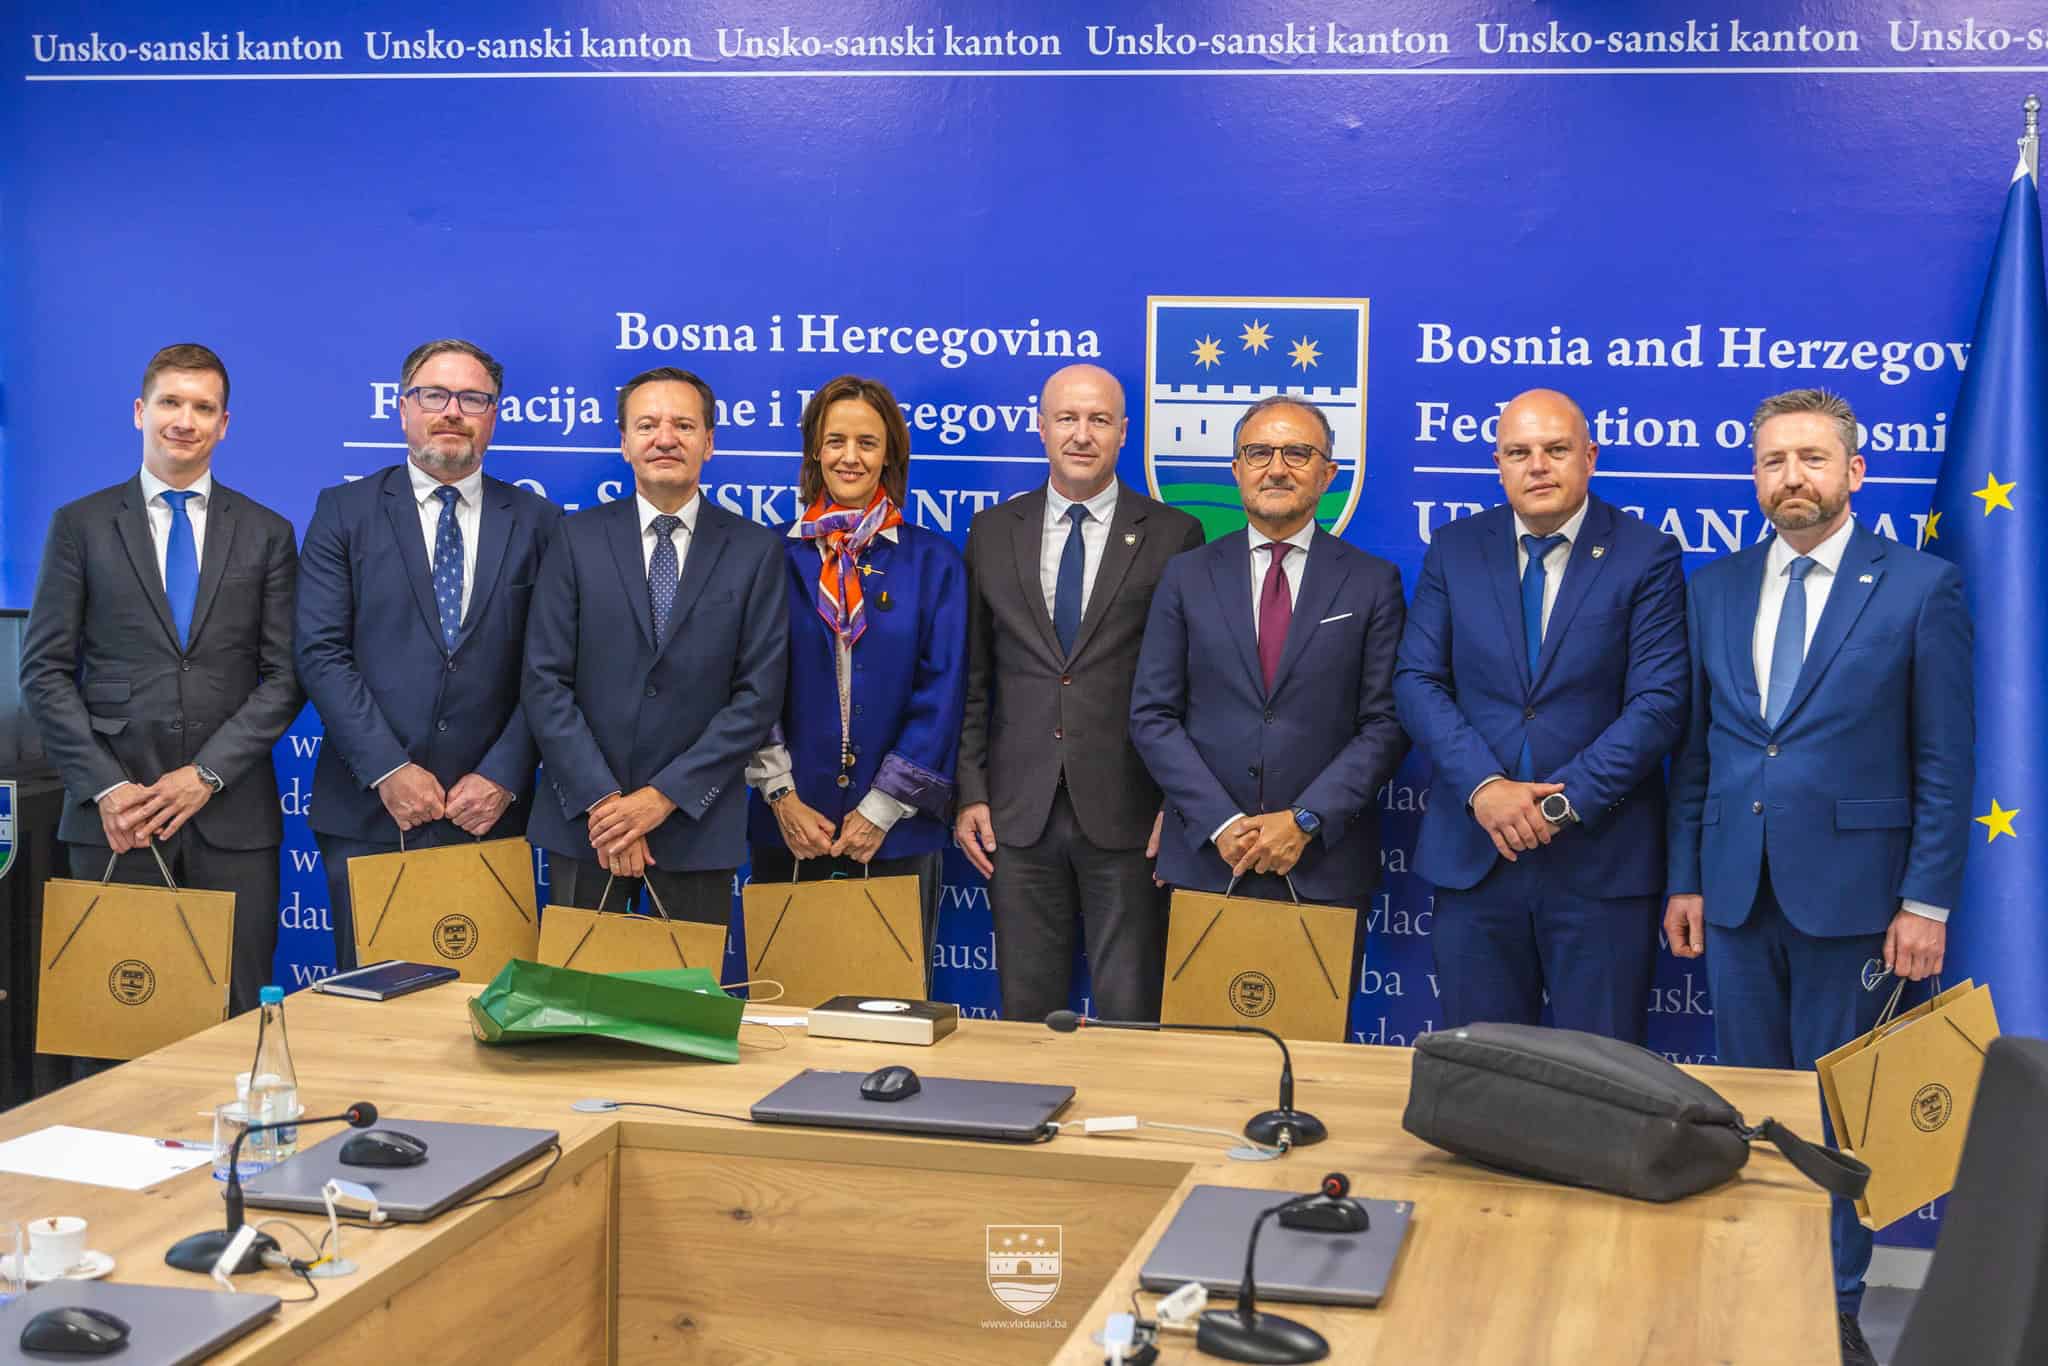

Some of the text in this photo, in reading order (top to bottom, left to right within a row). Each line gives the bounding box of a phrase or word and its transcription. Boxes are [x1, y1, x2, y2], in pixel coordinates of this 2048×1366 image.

[32, 16, 2048, 62] Unsko-sanski kanton Unsko-sanski kanton Unsko-sanski kanton Unsko-sanski kanton Unsko-sanski kanton Unsko-s
[615, 311, 1102, 369] Bosna i Hercegovina
[1415, 322, 1971, 386] Bosnia and Herzegov
[768, 390, 785, 427] i
